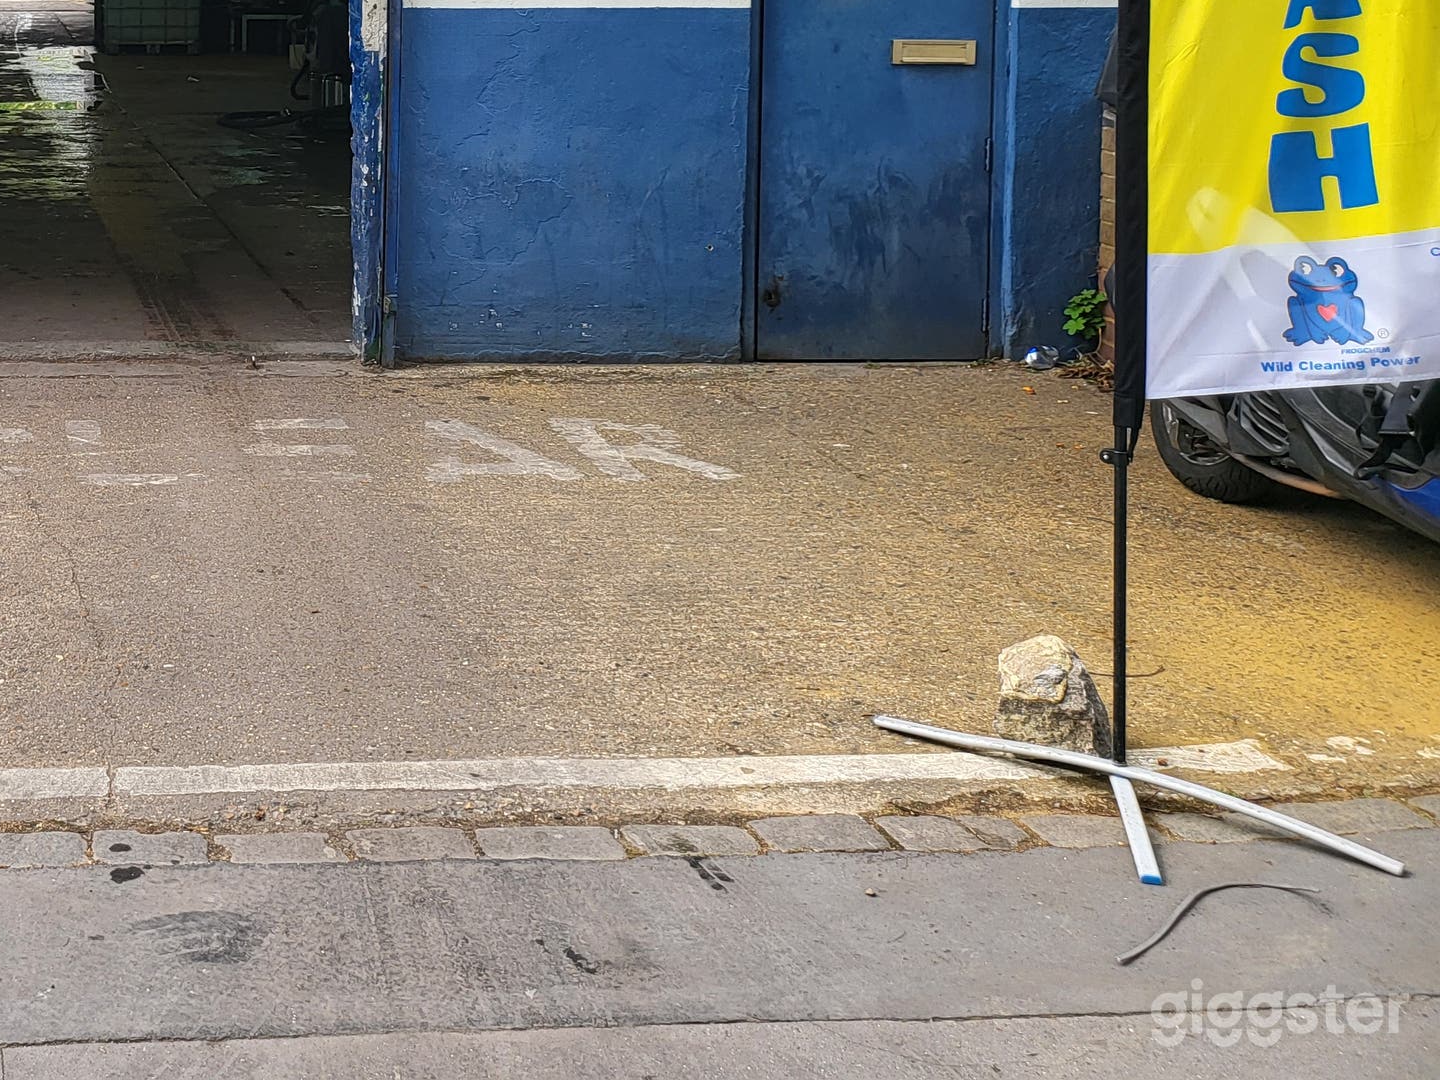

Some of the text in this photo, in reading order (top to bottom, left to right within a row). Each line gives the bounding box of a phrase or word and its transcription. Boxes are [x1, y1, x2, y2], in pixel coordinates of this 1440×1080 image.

[1261, 356, 1420, 372] Wild Cleaning Power
